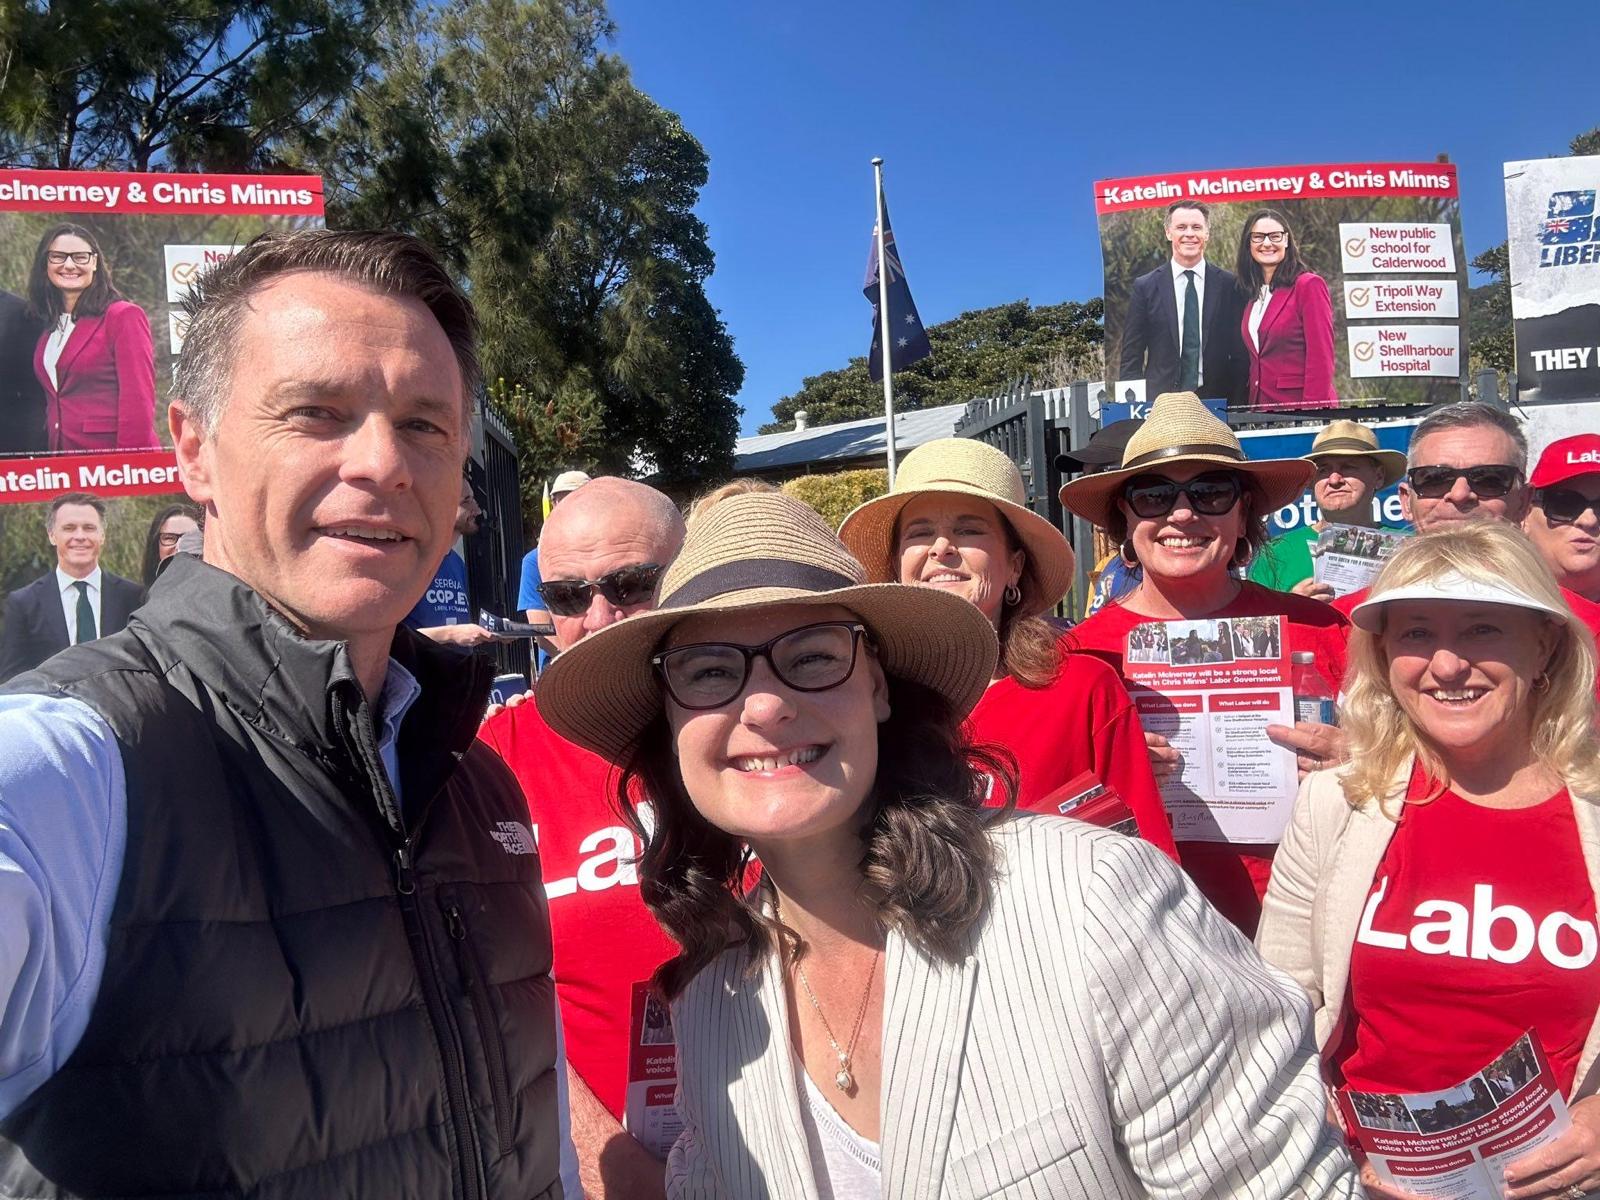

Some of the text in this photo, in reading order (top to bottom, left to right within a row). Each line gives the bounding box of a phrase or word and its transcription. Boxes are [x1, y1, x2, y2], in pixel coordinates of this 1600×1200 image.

[0, 180, 313, 207] cInerney & Chris Minns
[1103, 170, 1450, 205] Katelin McInerney & Chris Minns
[1370, 227, 1436, 241] New public
[1371, 242, 1430, 253] school for
[204, 250, 235, 263] Ne
[1372, 257, 1446, 268] Calderwood
[1374, 285, 1443, 299] Tripoli Way
[1375, 300, 1436, 312] Extension
[1378, 330, 1406, 341] New
[1380, 345, 1454, 357] Shellharbour
[1531, 347, 1591, 372] THEY
[1381, 360, 1430, 373] Hospital
[1130, 404, 1152, 420] Ka
[1567, 450, 1600, 464] Lab
[0, 464, 182, 491] telin McIner
[1259, 667, 1278, 675] local
[496, 822, 516, 831] THE
[489, 830, 521, 843] NORTH
[502, 843, 524, 854] FACE
[1356, 876, 1599, 969] Labo
[1372, 1137, 1405, 1146] Katelin
[1407, 1134, 1458, 1146] McInerney
[1460, 1126, 1476, 1137] will
[1477, 1122, 1489, 1130] be
[1498, 1101, 1525, 1119] strong
[1525, 1084, 1543, 1102] local
[1377, 1144, 1401, 1152] voice
[1414, 1144, 1440, 1152] Chris
[1442, 1134, 1473, 1149] Minns'
[1475, 1123, 1500, 1138] Labor
[1502, 1088, 1548, 1125] Government
[1491, 1141, 1510, 1150] What
[1510, 1132, 1528, 1143] Labor
[1528, 1124, 1538, 1133] will
[1539, 1119, 1546, 1127] do
[1449, 1158, 1467, 1166] done
